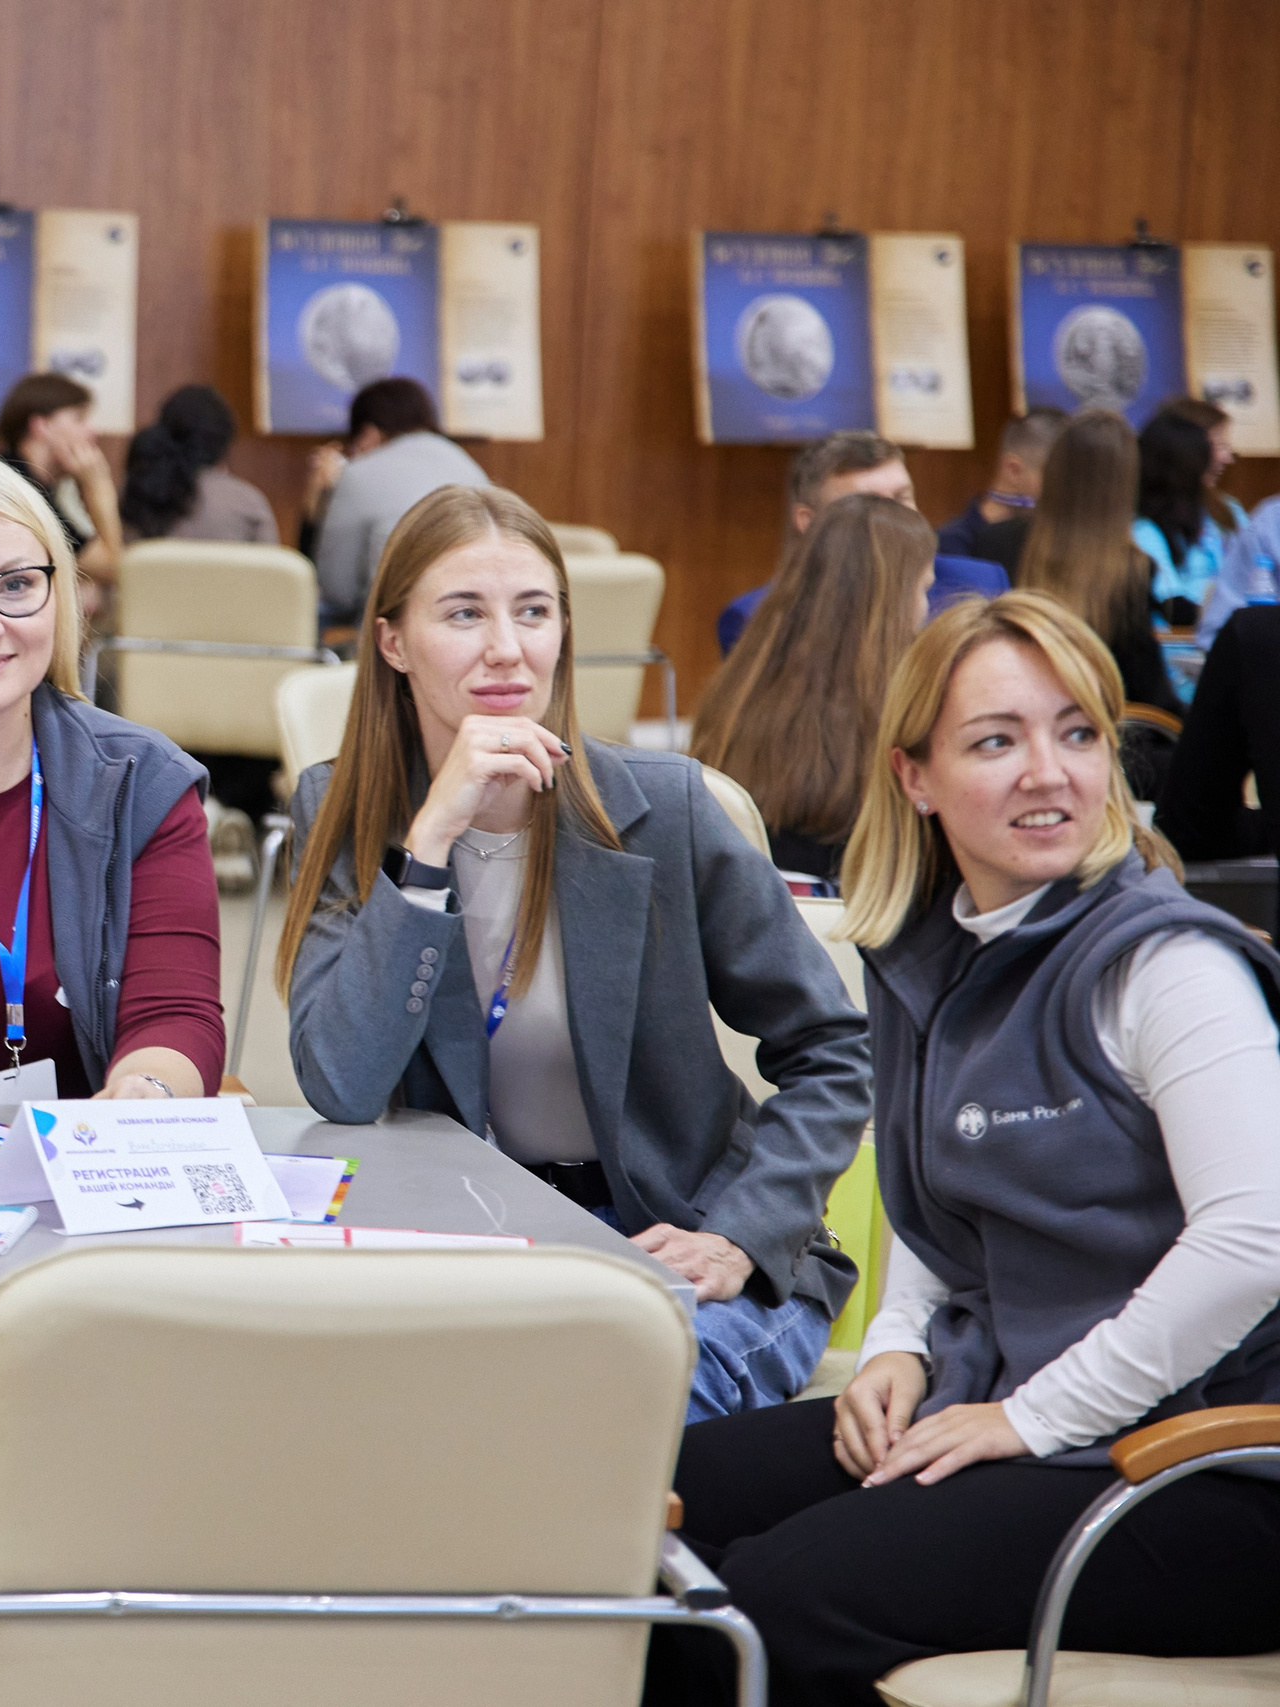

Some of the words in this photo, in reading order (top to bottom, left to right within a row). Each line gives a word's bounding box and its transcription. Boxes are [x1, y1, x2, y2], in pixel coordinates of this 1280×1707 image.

[156, 1116, 180, 1124] ВАШЕЙ
[182, 1116, 217, 1124] КОМАНДЫ
[993, 1110, 1030, 1124] Банк
[72, 1166, 171, 1180] РЕГИСТРАЦИЯ
[79, 1182, 118, 1193] ВАШЕЙ
[119, 1180, 176, 1191] КОМАНДЫ
